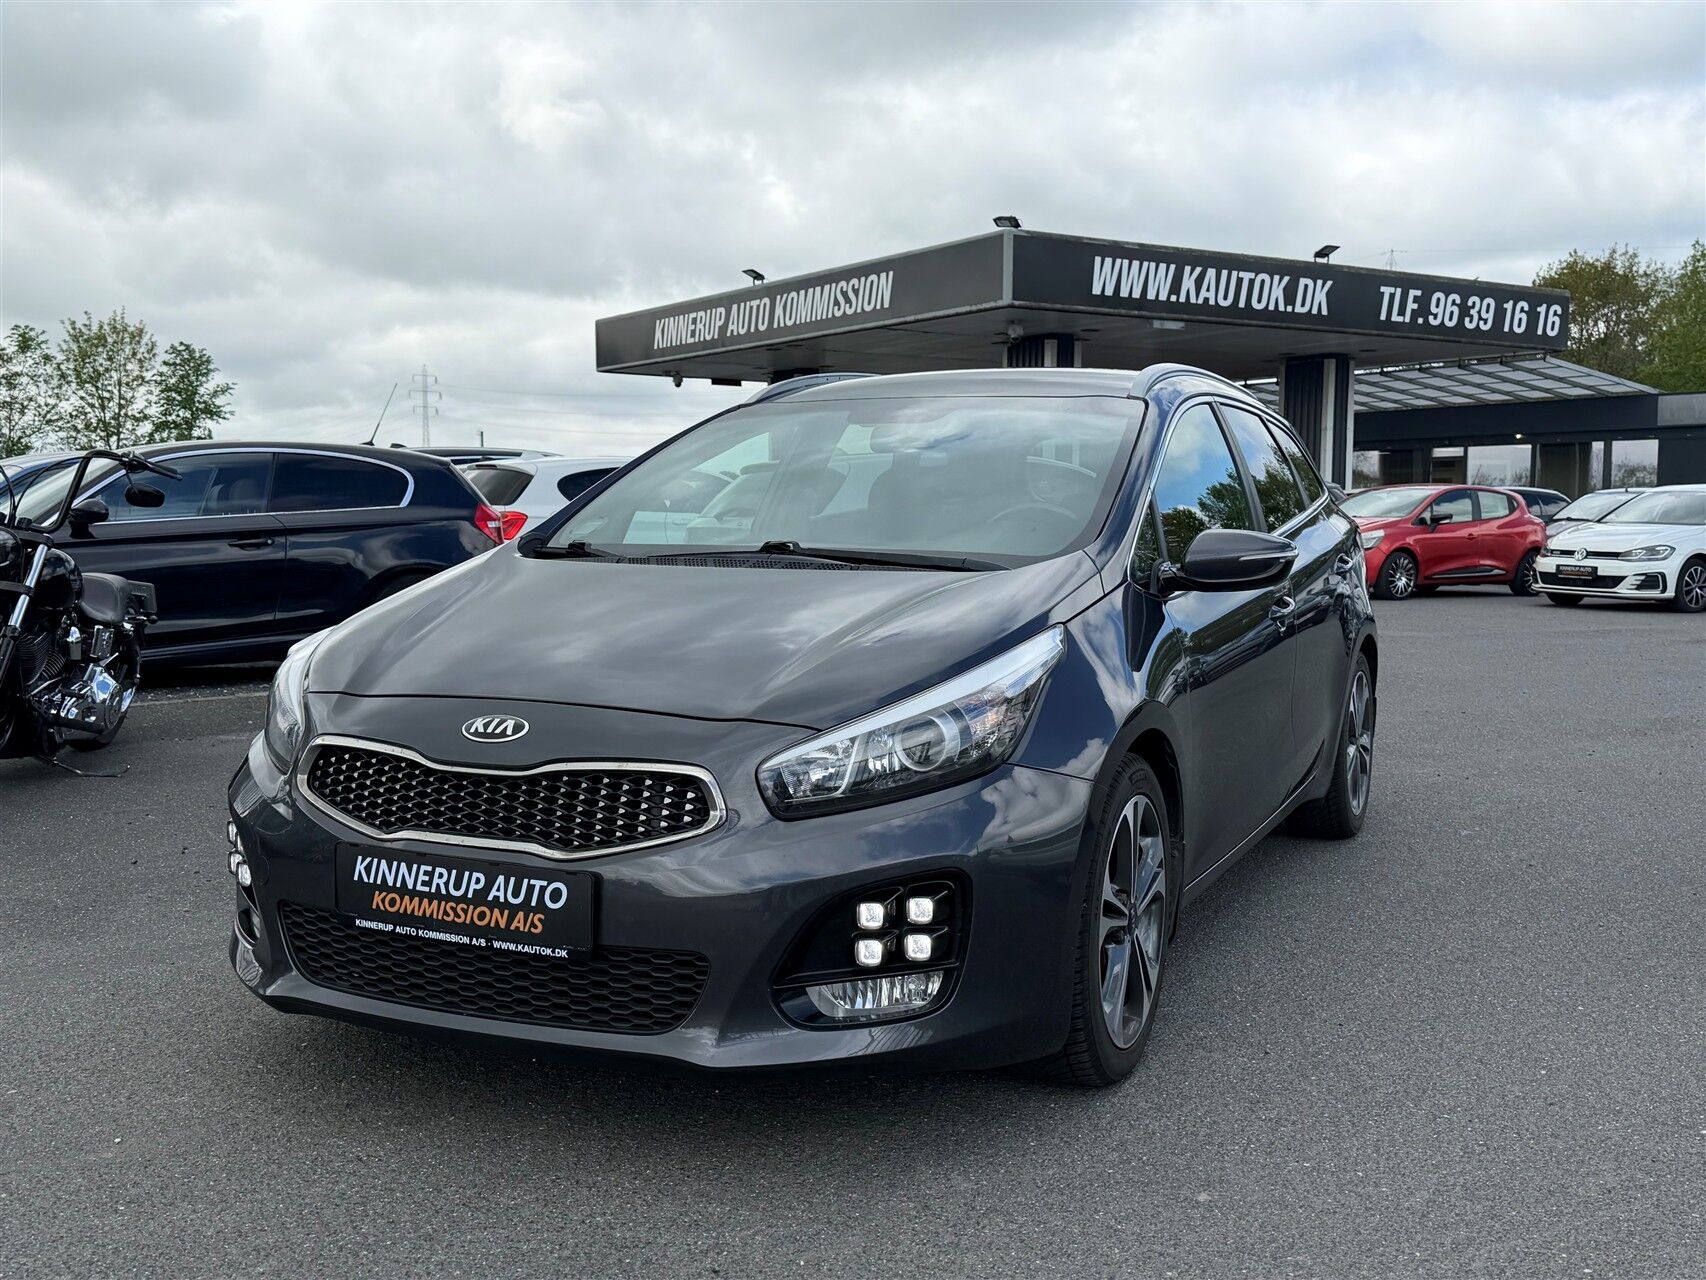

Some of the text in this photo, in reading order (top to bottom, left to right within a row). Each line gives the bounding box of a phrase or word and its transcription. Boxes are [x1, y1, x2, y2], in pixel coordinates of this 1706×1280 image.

[653, 270, 894, 350] KINNERUP AUTO KOMMISSION
[1091, 256, 1333, 316] WWW.KAUTOK.DK
[1379, 286, 1563, 338] TLF. 96 39 16 16
[469, 717, 516, 736] KIA
[353, 855, 568, 910] KINNERUP AUTO
[355, 918, 568, 958] KINNERUP AUTO KOMMISSION A/S WWW.KAUTOK.DK
[372, 890, 545, 934] KOMMISSION A/S
